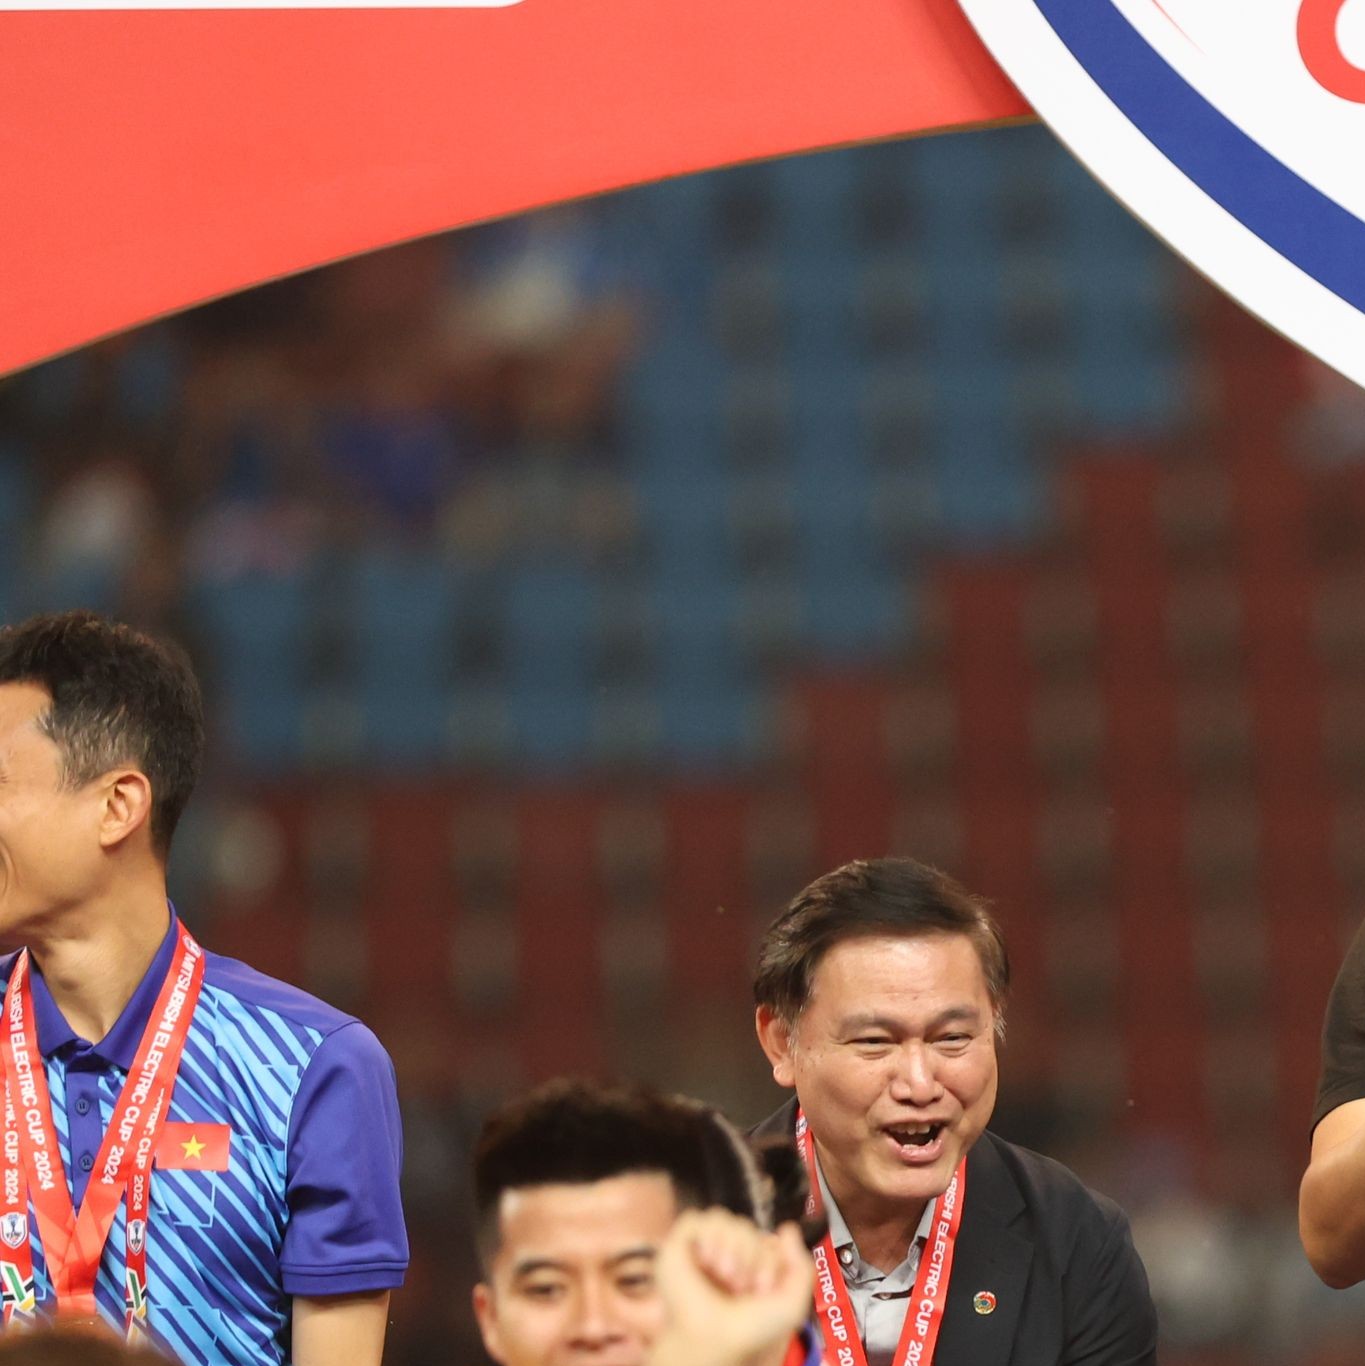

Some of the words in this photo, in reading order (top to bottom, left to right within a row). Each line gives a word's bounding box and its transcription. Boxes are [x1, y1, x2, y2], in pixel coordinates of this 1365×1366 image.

[159, 951, 197, 1032] MITSUBISHI
[10, 1031, 38, 1107] ELECTRIC
[131, 1031, 170, 1105] ELECTRIC
[25, 1109, 45, 1146] CUP
[118, 1106, 141, 1142] CUP
[5, 1129, 19, 1162] CUP
[101, 1144, 124, 1185] 2024
[136, 1137, 152, 1170] CUP
[4, 1168, 19, 1205] 2024
[34, 1151, 55, 1191] 2024
[133, 1174, 144, 1211] 2024
[923, 1221, 949, 1297] ELECTRIC
[813, 1245, 838, 1304] ECTRIC
[827, 1304, 848, 1342] CUP
[915, 1299, 934, 1337] CUP
